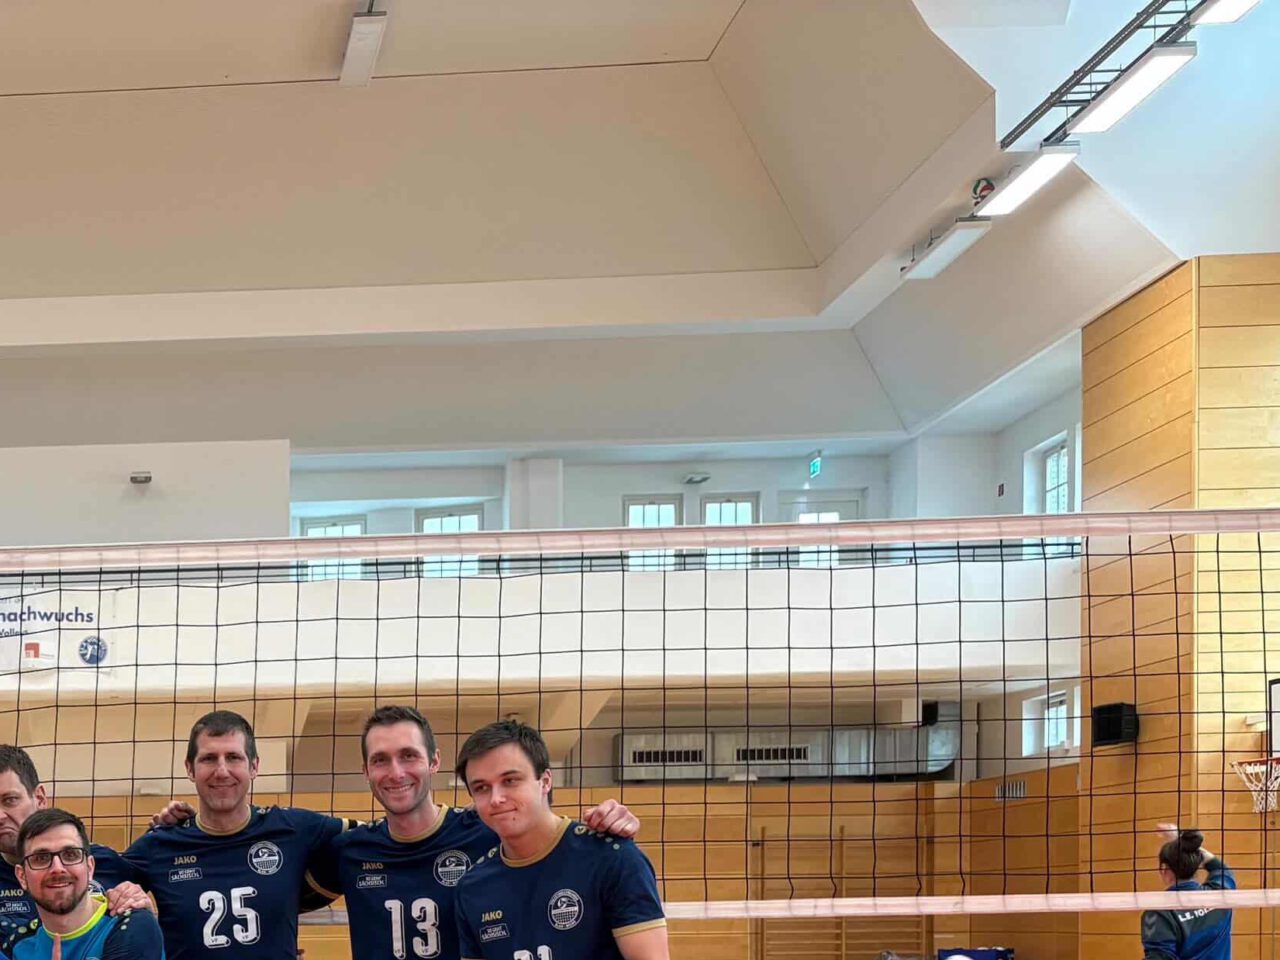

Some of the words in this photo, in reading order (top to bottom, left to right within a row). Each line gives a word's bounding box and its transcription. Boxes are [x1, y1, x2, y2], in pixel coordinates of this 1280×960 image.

[173, 855, 197, 865] JAKO
[361, 862, 384, 870] JAKO
[0, 889, 24, 898] JAKO
[199, 886, 260, 949] 25
[481, 910, 503, 922] JAKO
[384, 897, 441, 960] 13
